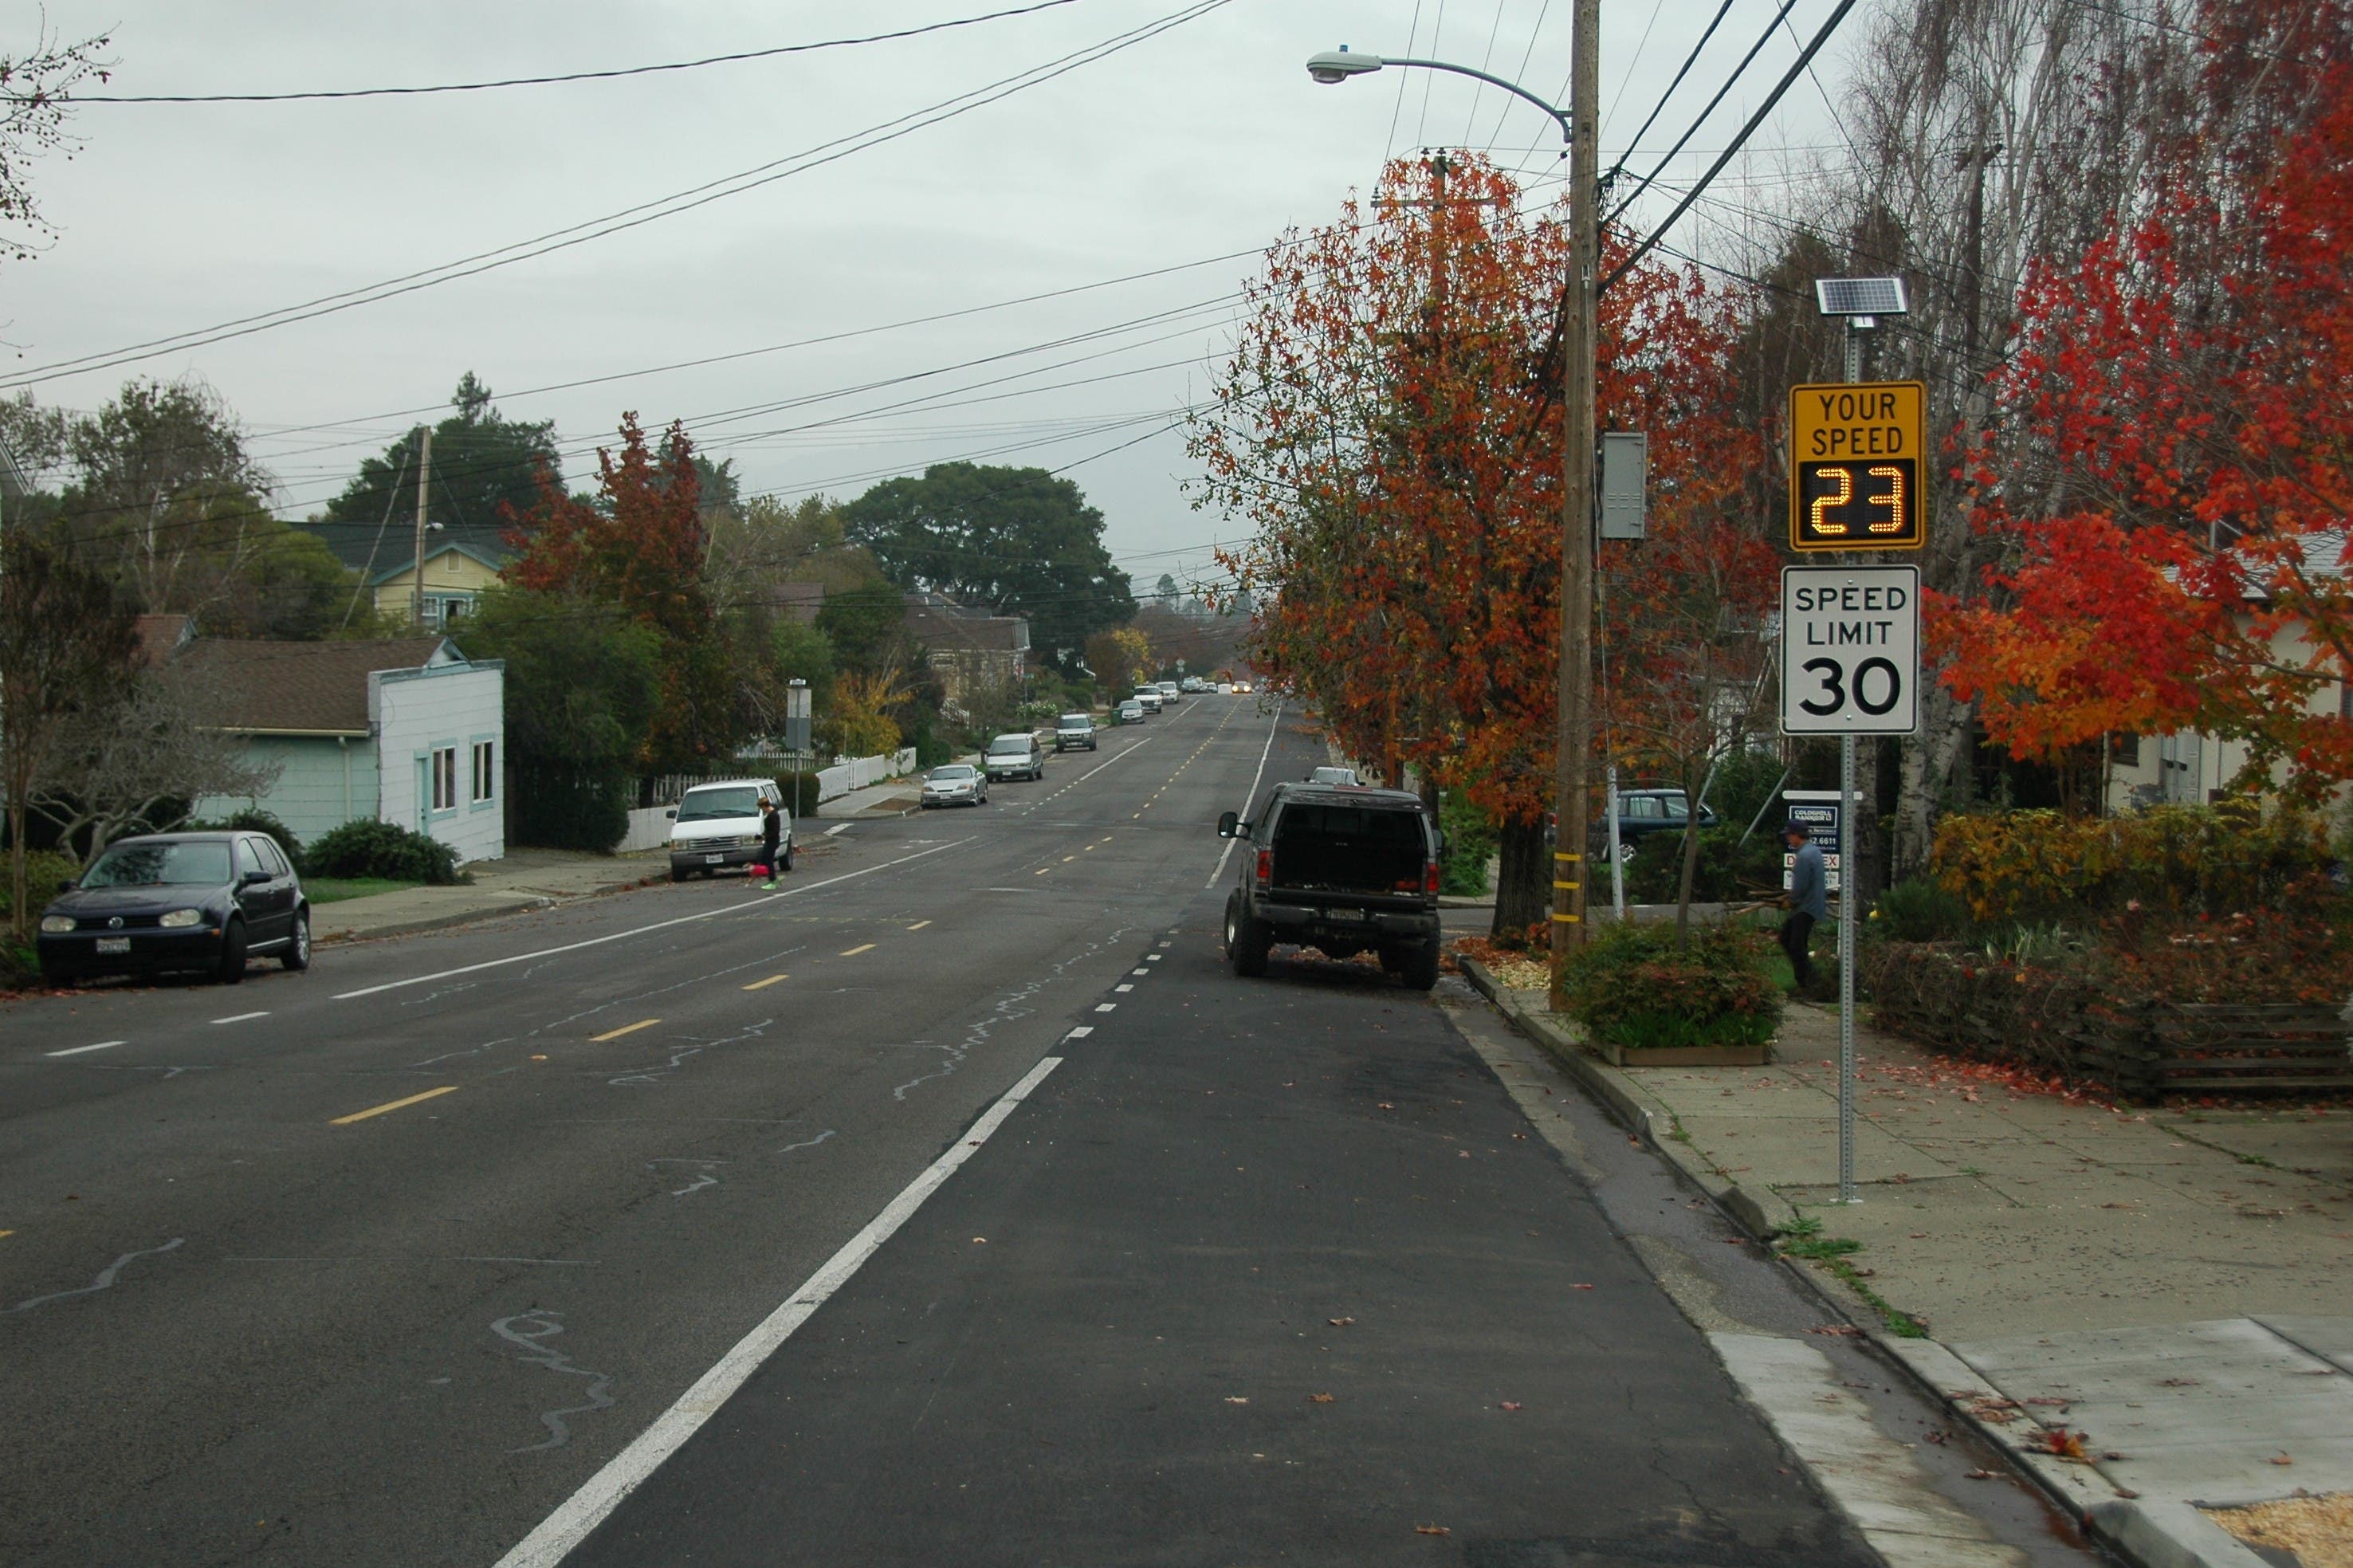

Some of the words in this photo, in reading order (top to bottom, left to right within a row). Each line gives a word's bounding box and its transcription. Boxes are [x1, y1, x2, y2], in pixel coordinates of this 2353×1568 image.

[1818, 393, 1896, 421] YOUR
[1811, 426, 1903, 456] SPEED
[1811, 466, 1903, 534] 23
[1794, 587, 1907, 611] SPEED
[1806, 621, 1893, 646] LIMIT
[1798, 656, 1901, 717] 30
